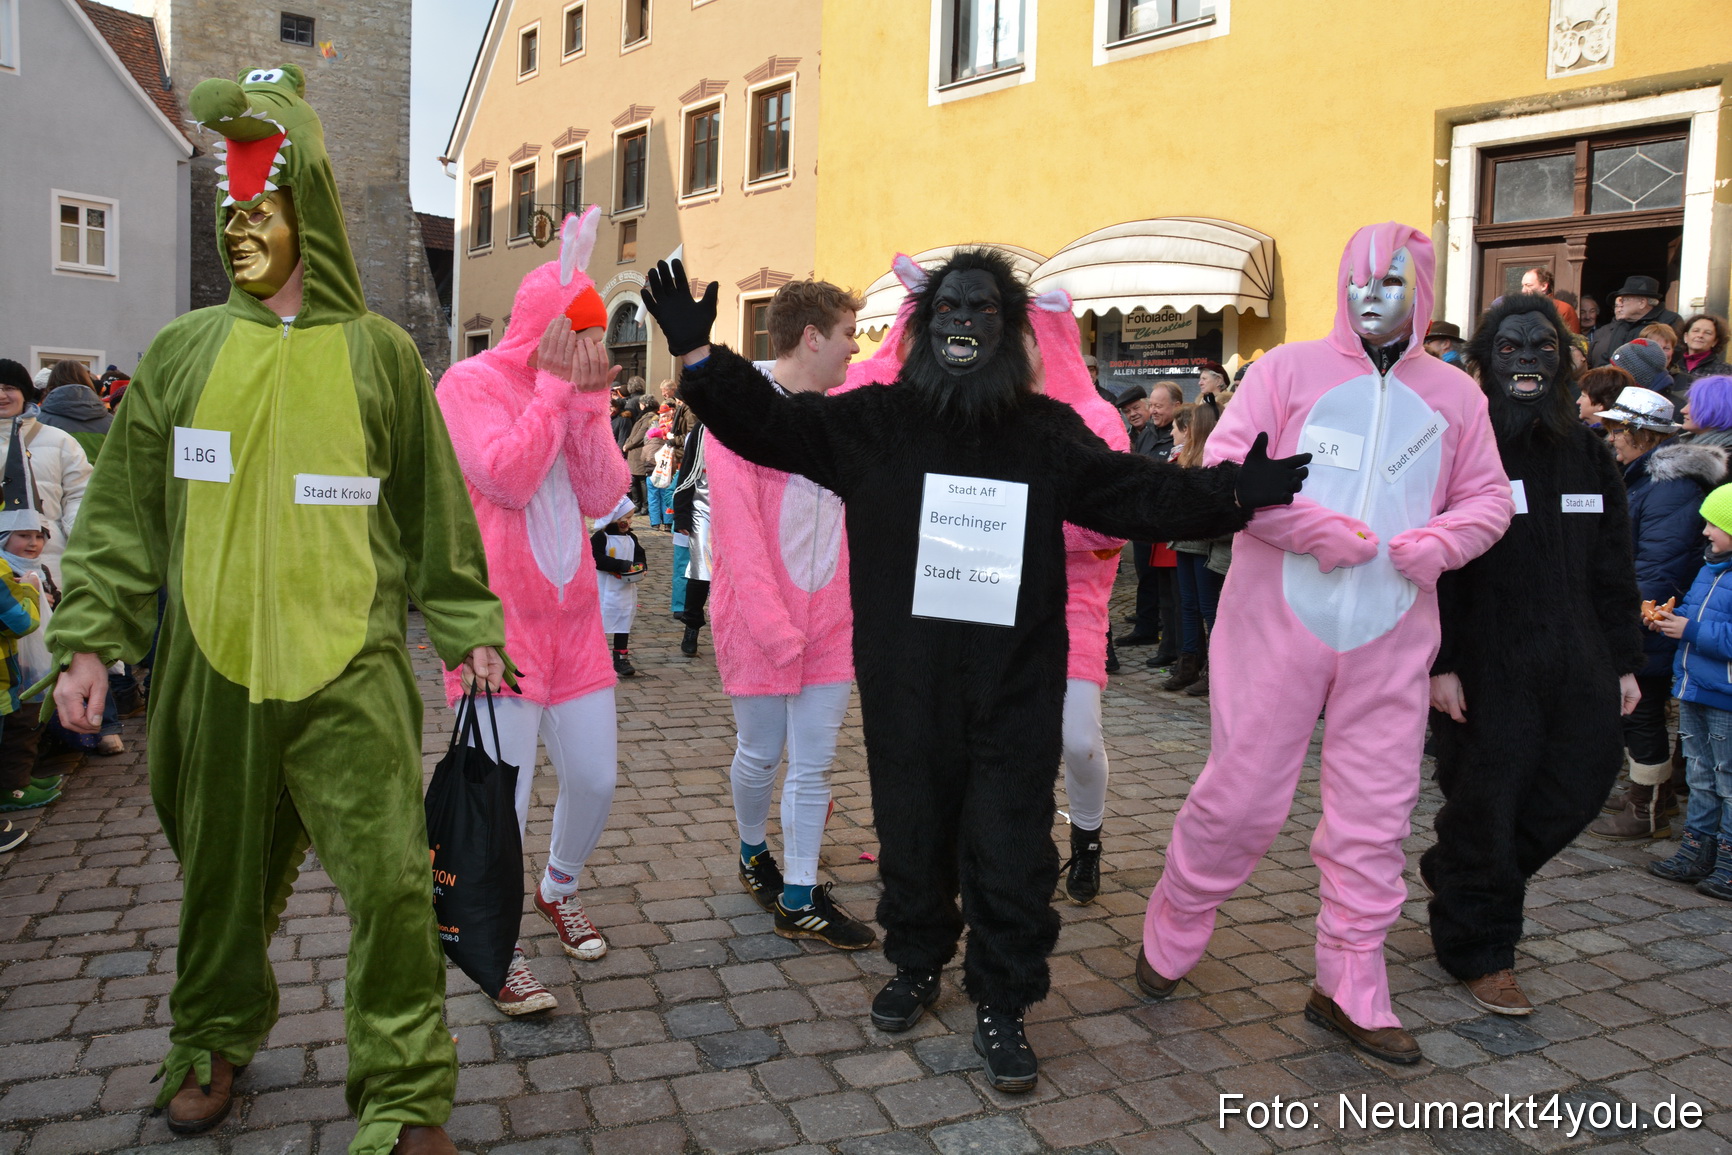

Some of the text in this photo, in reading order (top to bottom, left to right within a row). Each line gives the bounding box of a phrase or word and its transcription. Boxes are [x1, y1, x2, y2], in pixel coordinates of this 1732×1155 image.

[1127, 310, 1182, 324] Fotoladen
[1134, 320, 1192, 340] Christine
[1143, 349, 1166, 357] geöffnet
[1109, 357, 1208, 368] DIGITALE FARBBILDER VON
[1113, 366, 1201, 376] ALLEN SPEICHERMEDIE
[183, 446, 216, 463] 1.BG
[1318, 442, 1340, 456] S.R
[1387, 423, 1440, 475] Stadt Rammler
[303, 485, 372, 500] Stadt Kroko
[948, 484, 997, 497] Stadt Aff
[1565, 498, 1596, 508] Stadt Aff
[930, 511, 1007, 532] Berchinger
[923, 564, 1000, 585] Stadt ZOO
